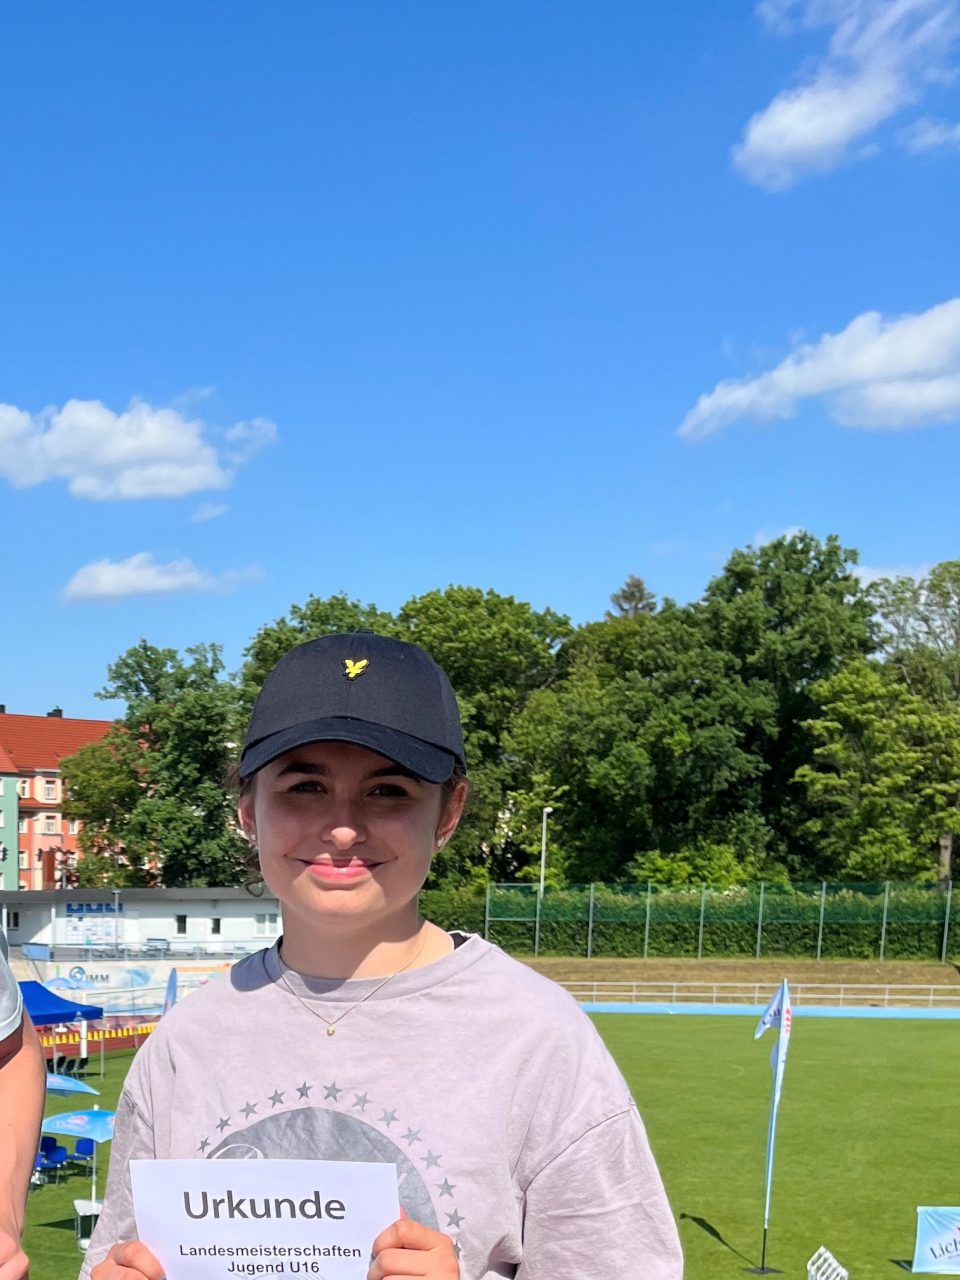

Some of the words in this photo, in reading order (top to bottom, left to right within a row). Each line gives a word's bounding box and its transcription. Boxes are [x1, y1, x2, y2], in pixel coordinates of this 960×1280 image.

[183, 1190, 346, 1220] Urkunde
[179, 1244, 362, 1258] Landesmeisterschaften
[227, 1262, 284, 1275] Jugend
[289, 1262, 320, 1273] U16
